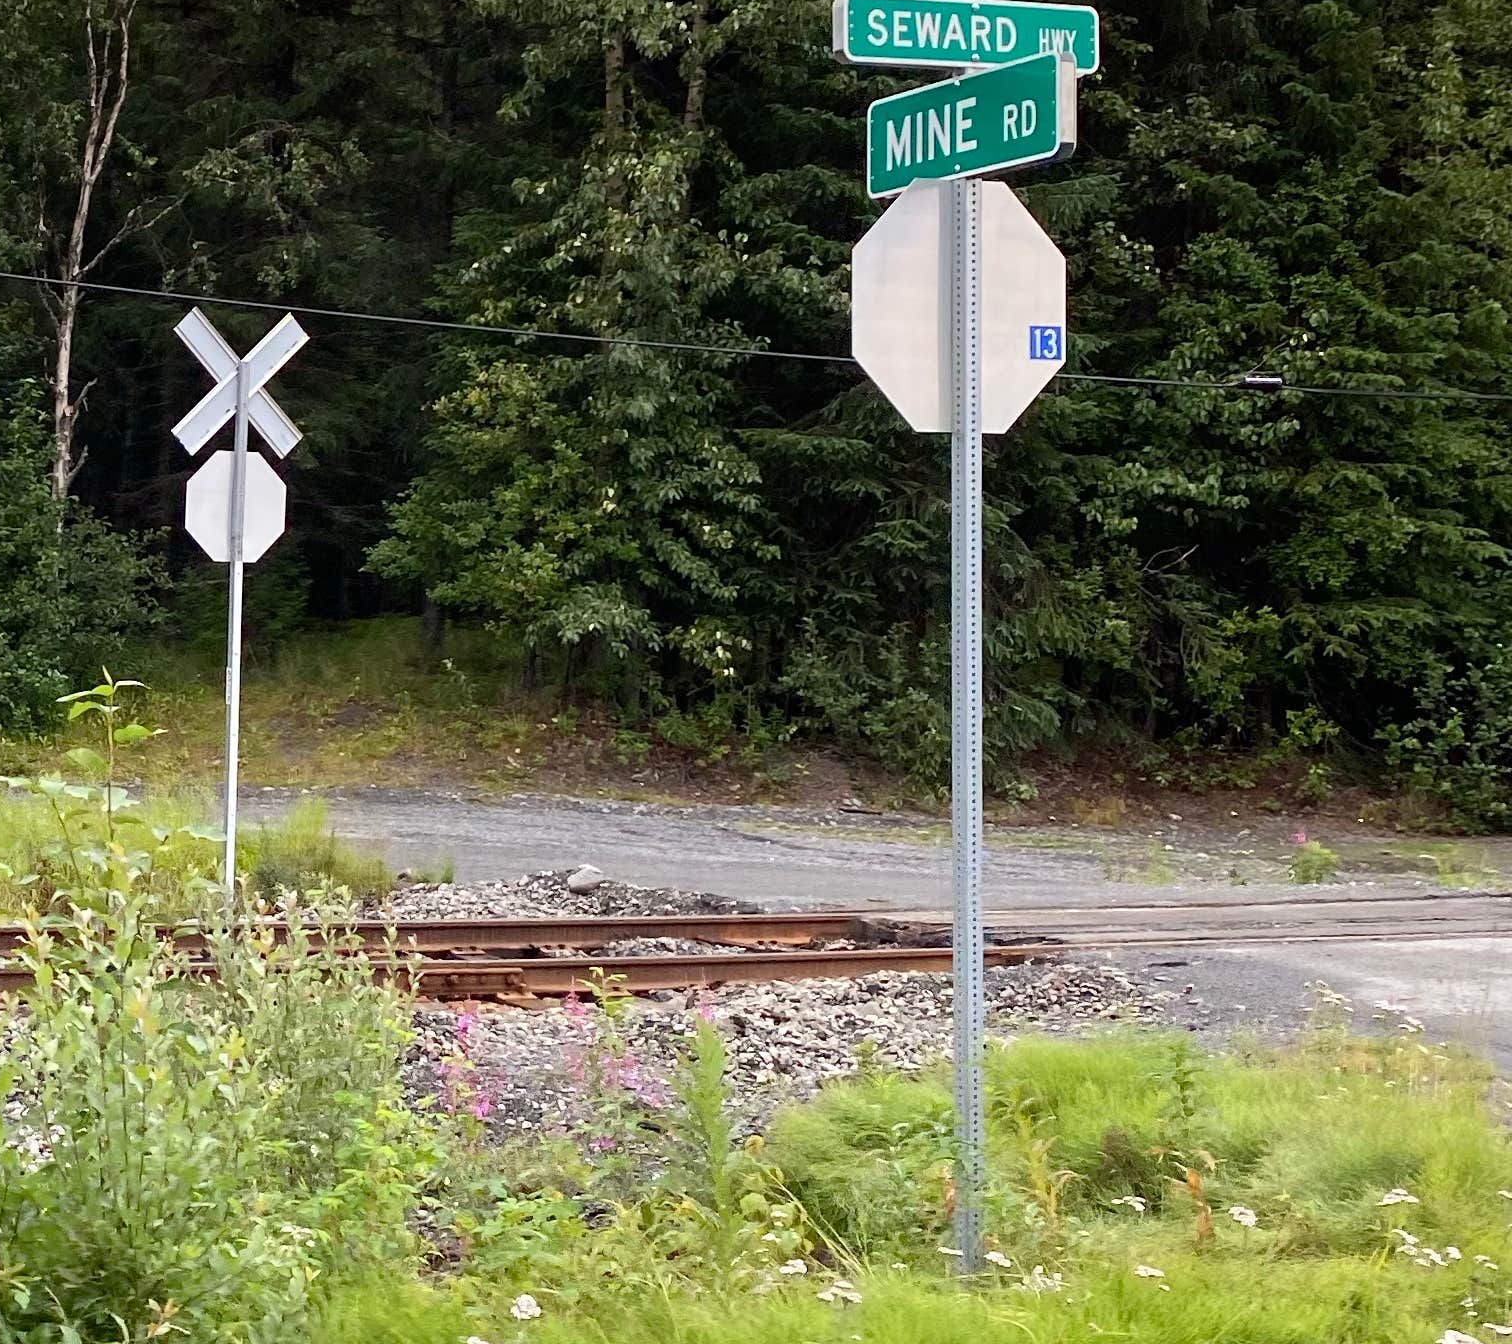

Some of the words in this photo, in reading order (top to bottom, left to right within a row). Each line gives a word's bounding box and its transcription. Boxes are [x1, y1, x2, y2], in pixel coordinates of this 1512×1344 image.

[867, 9, 1017, 53] SEWARD
[1038, 27, 1077, 54] HWY
[886, 96, 977, 171] MINE
[1003, 99, 1037, 142] RD
[1034, 328, 1057, 358] 13
